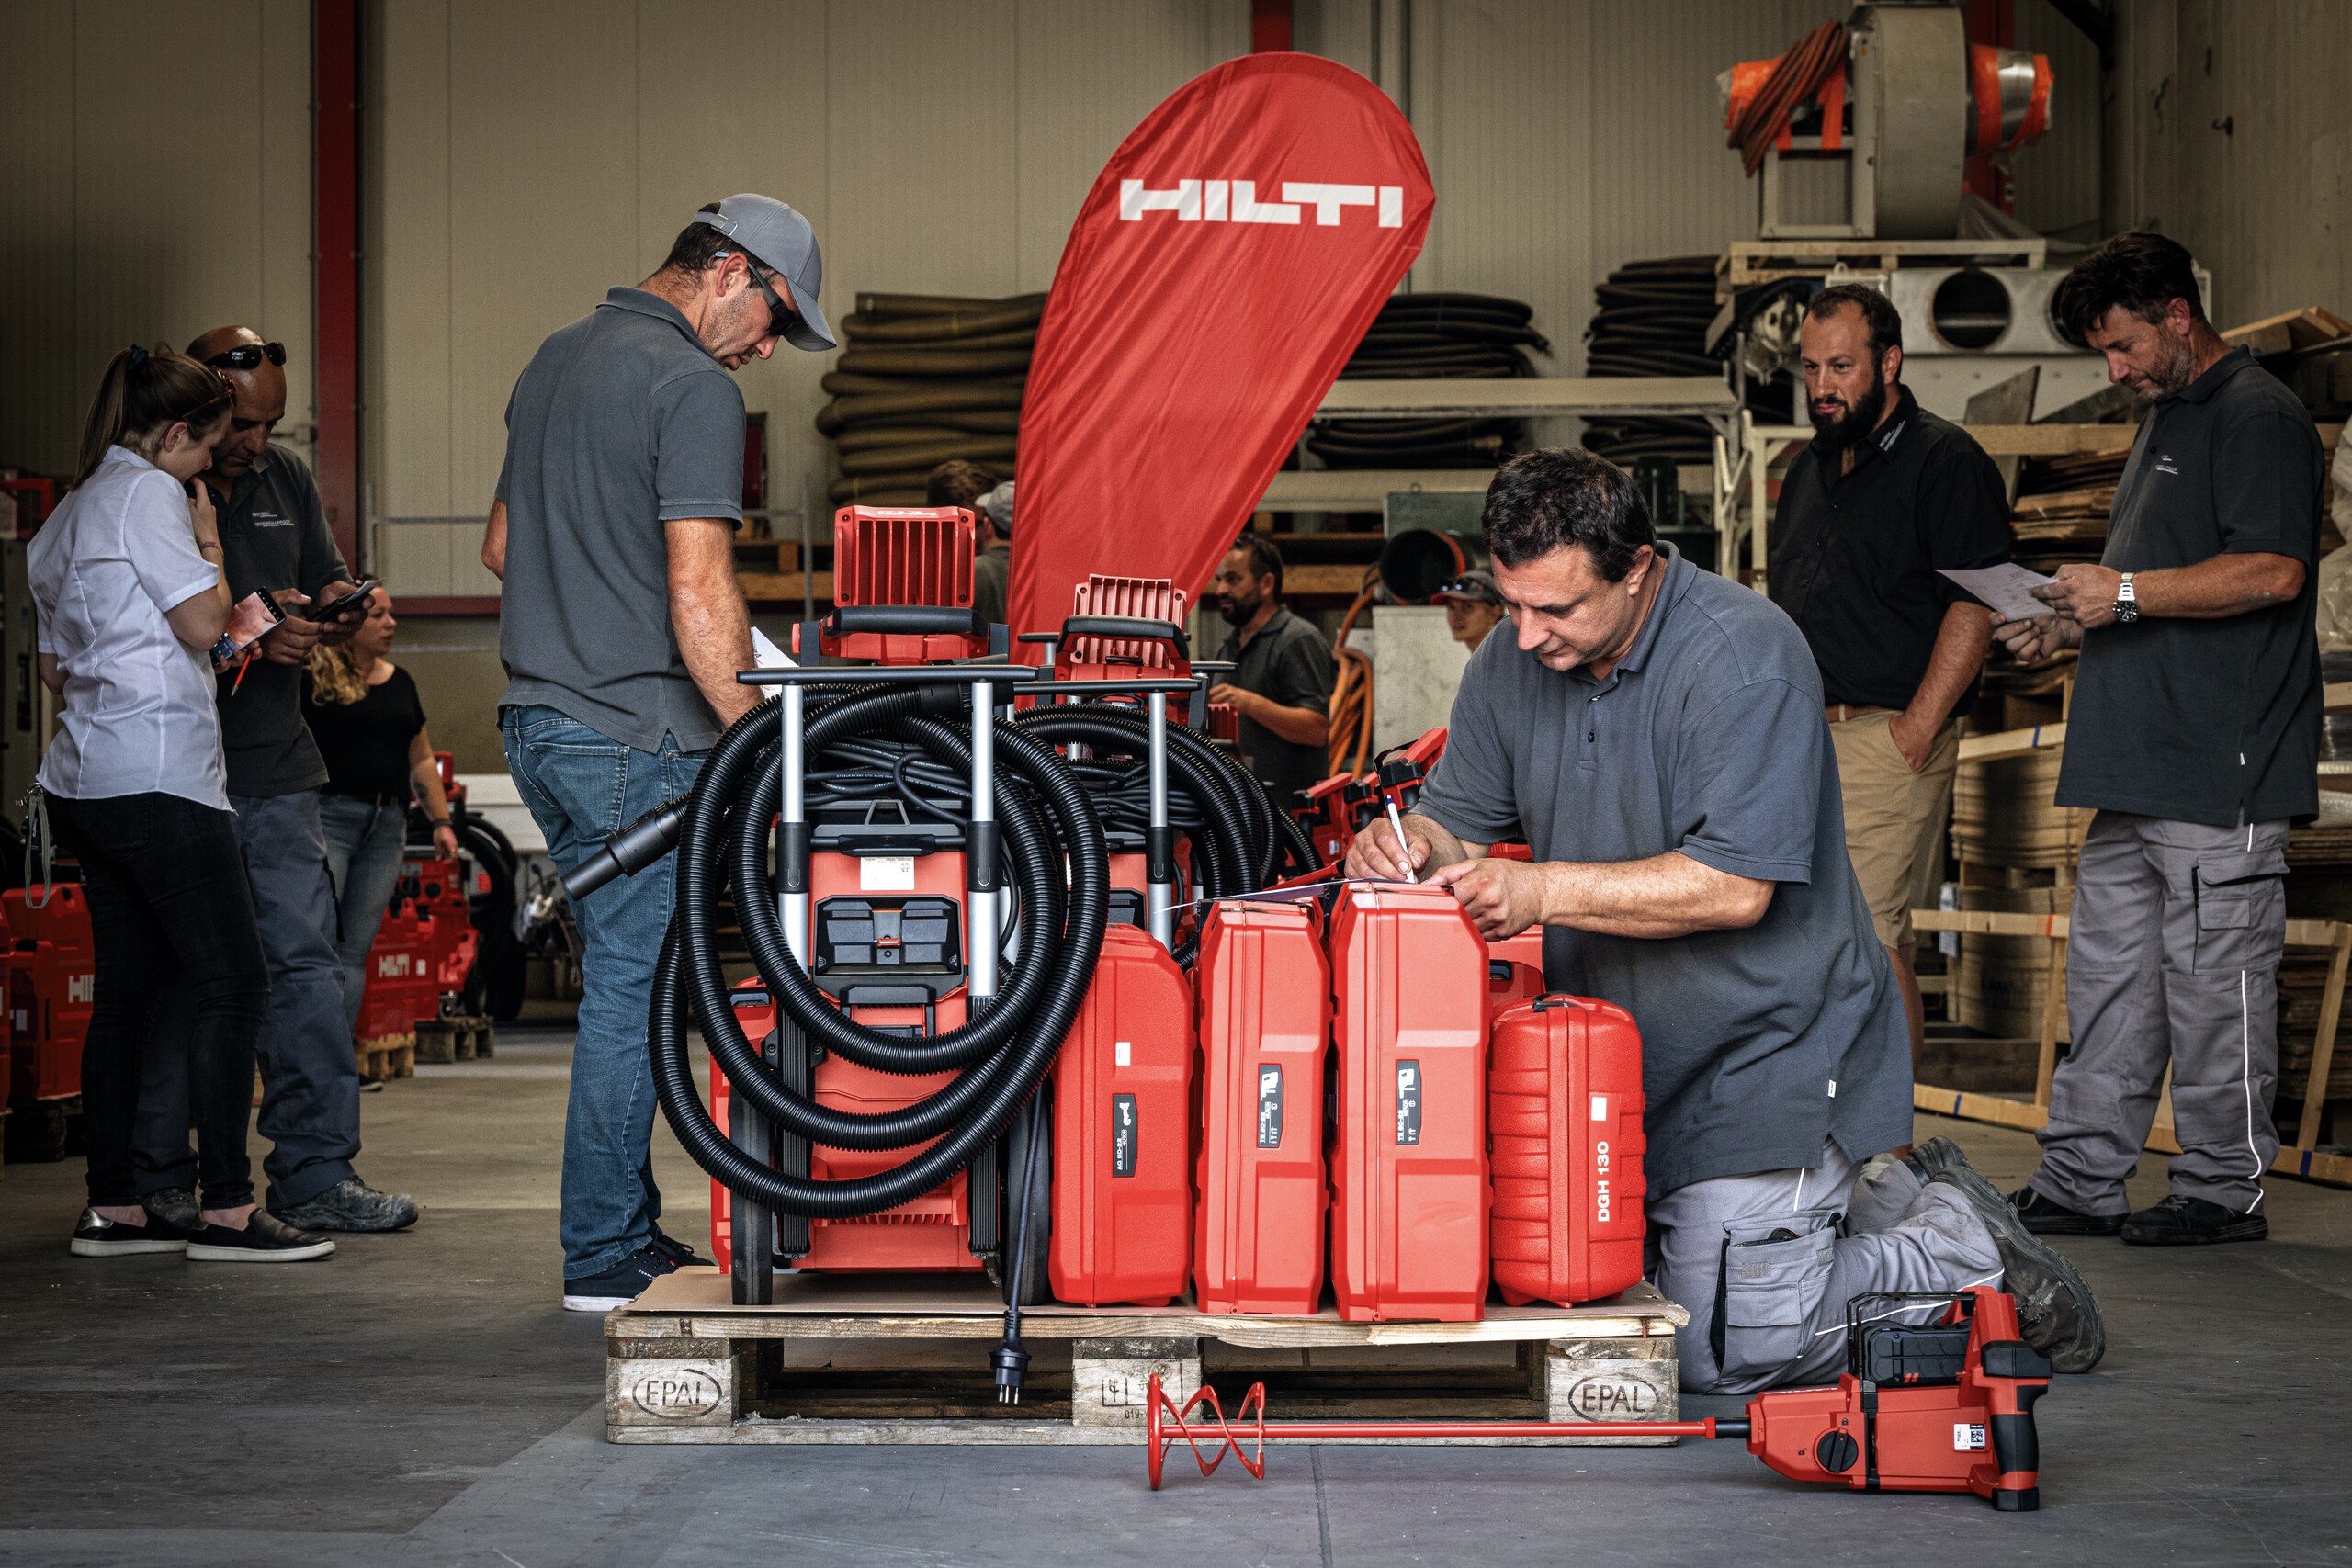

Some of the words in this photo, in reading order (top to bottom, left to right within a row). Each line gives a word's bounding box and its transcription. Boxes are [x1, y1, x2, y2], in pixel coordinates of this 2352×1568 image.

[1119, 179, 1403, 228] HILTI
[1116, 1160, 1123, 1170] AG
[1597, 1141, 1609, 1176] 130
[1597, 1180, 1610, 1222] DGH
[646, 1380, 708, 1406] EPAL
[1582, 1384, 1645, 1413] EPAL
